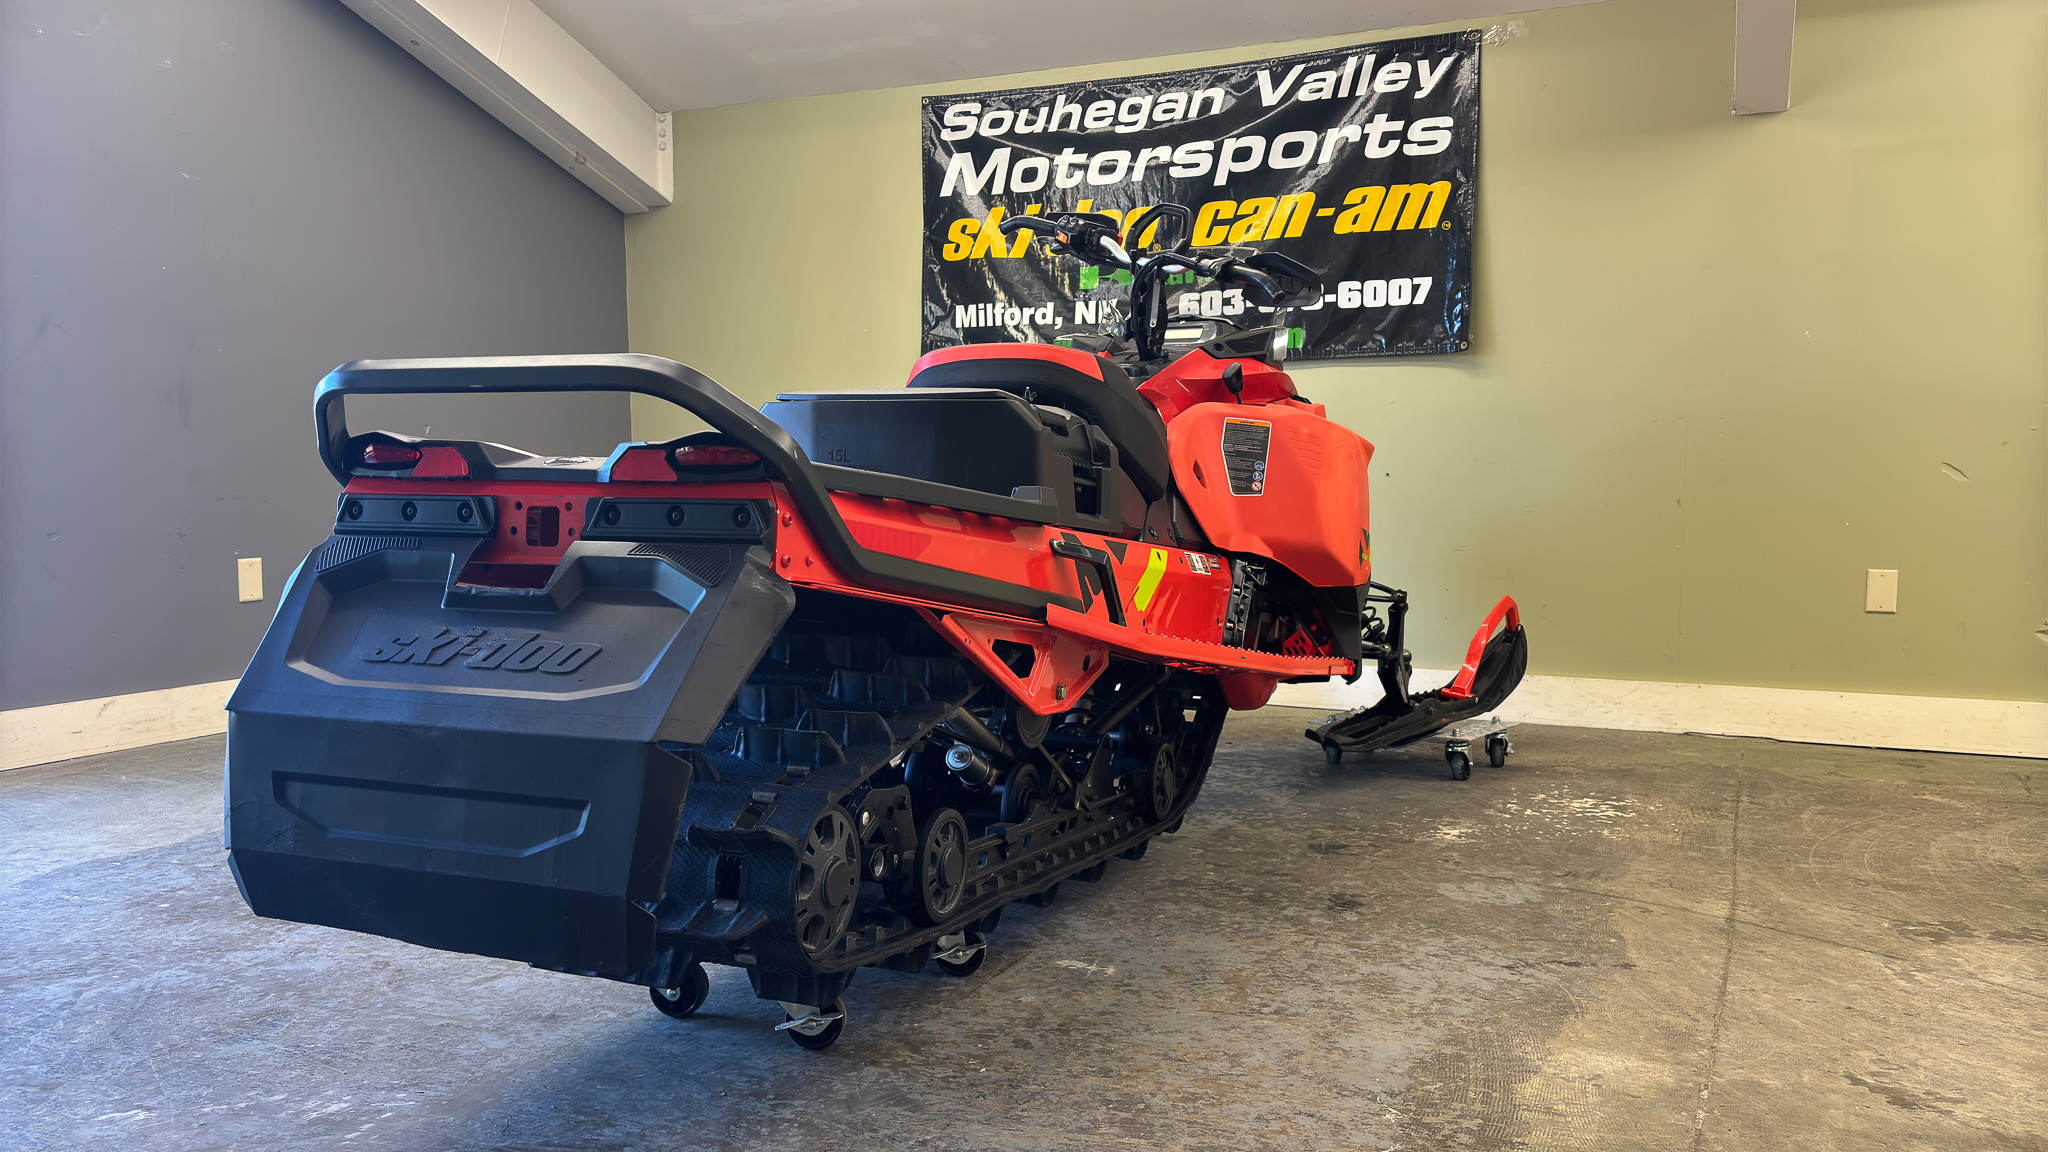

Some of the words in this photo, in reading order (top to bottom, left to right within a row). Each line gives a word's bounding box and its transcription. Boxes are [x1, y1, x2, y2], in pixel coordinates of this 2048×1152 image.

[940, 88, 1226, 141] Souhegan
[1257, 53, 1455, 108] Valley
[940, 113, 1454, 197] Motorsports
[1191, 180, 1452, 247] can-am
[955, 301, 1064, 330] Milford,
[828, 449, 851, 462] 15L
